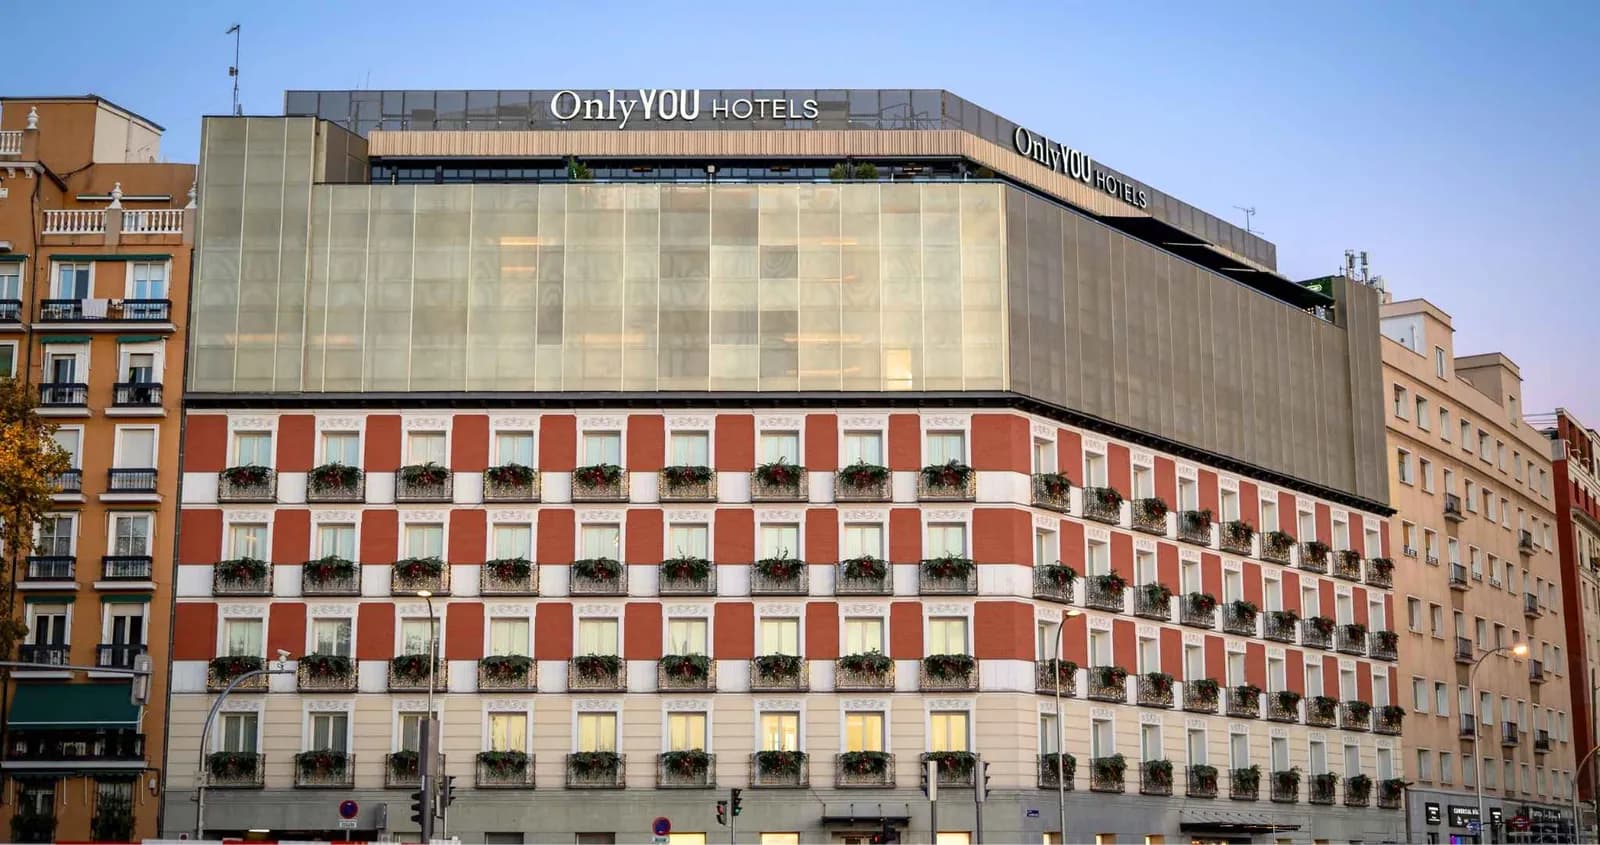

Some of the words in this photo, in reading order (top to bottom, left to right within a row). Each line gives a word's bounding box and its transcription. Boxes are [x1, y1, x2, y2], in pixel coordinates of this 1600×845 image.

[550, 89, 699, 129] OnlyYOU
[712, 98, 819, 119] HOTELS
[1015, 126, 1091, 183] OnlyYOU
[1096, 168, 1147, 209] HOTELS
